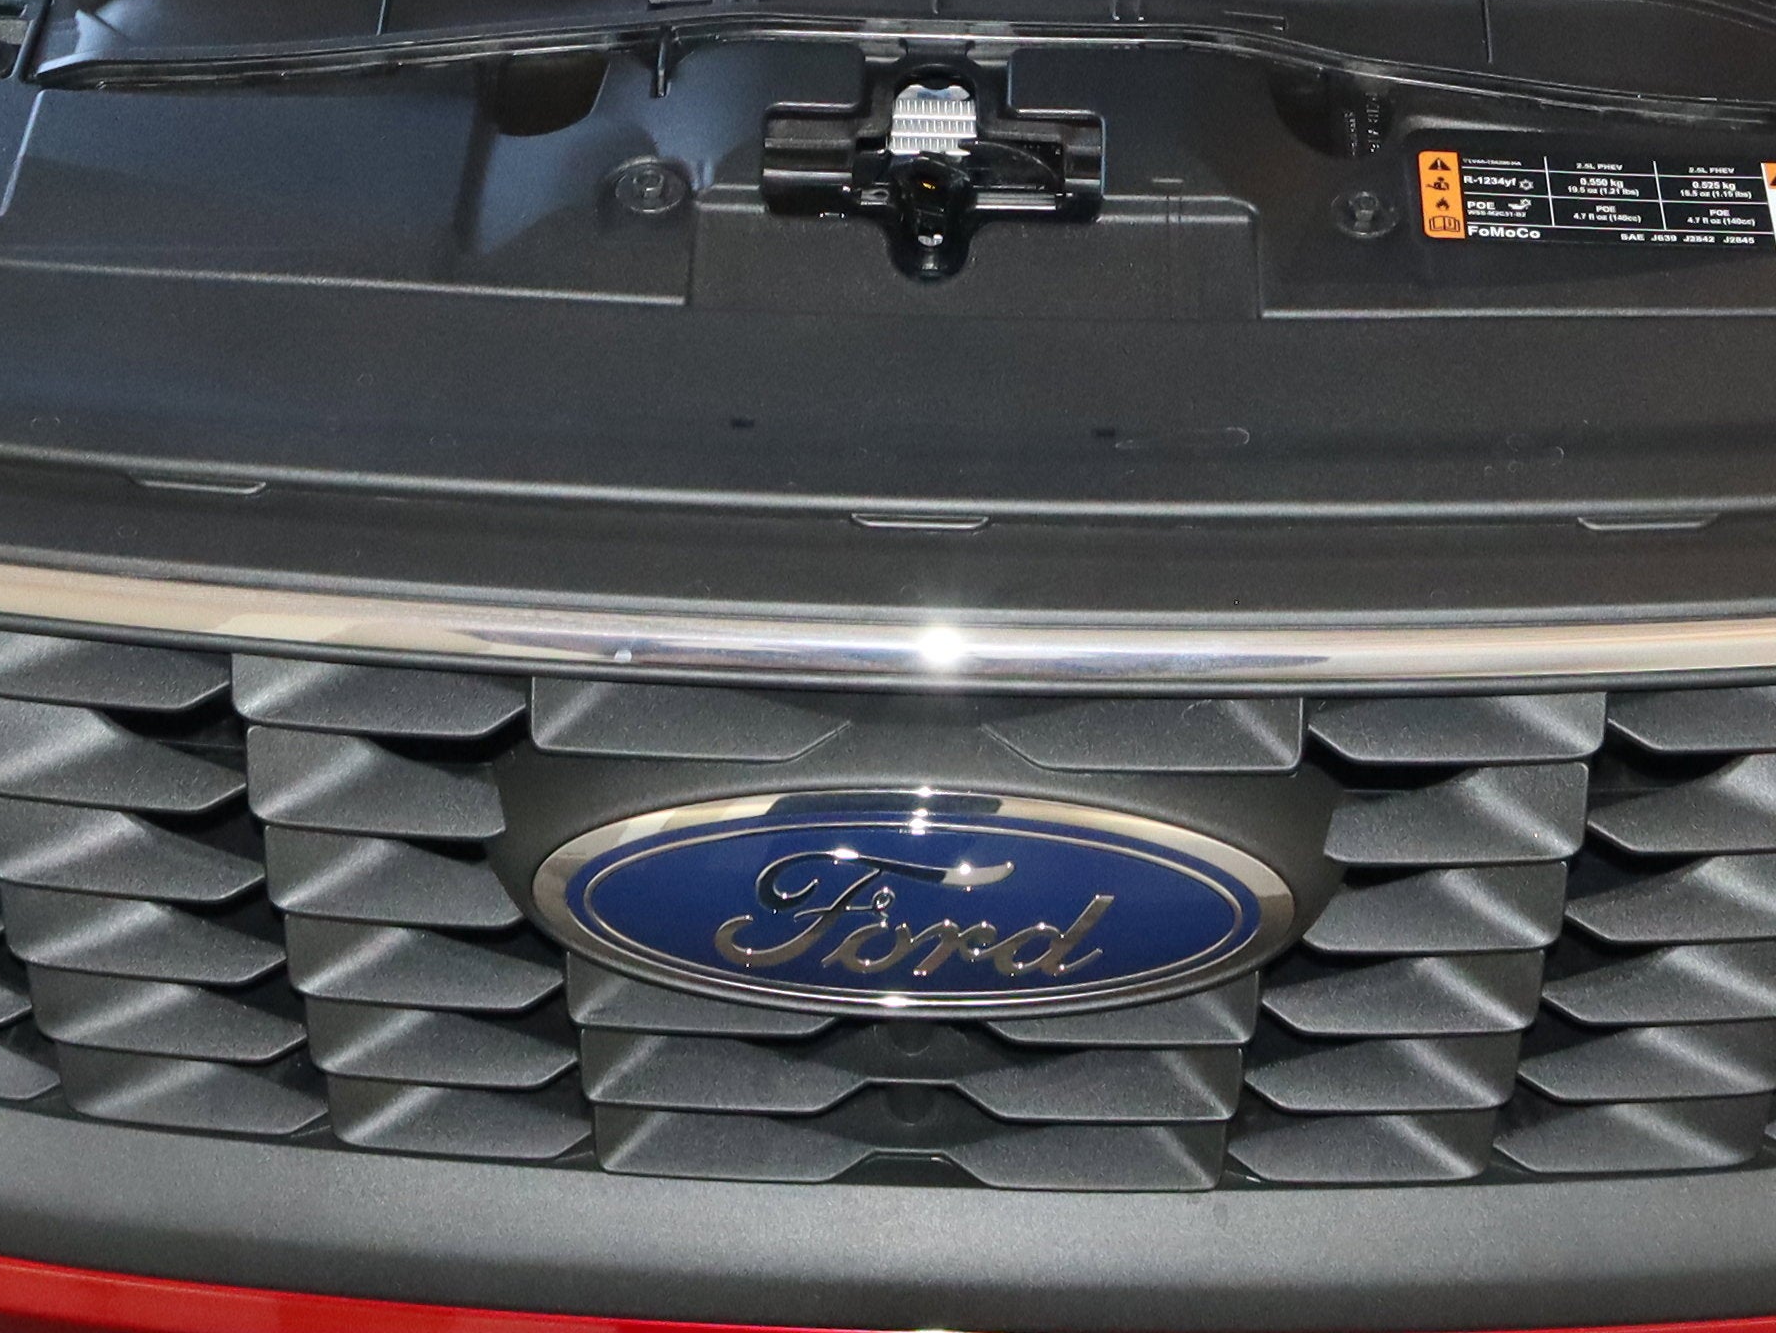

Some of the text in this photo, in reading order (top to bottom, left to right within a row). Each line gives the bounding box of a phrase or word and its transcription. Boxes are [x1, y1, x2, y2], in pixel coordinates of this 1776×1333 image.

[1462, 175, 1517, 188] R-1234yf
[1579, 177, 1624, 188] 0.550 kg
[1692, 181, 1736, 191] 0.525 kg
[1467, 201, 1495, 210] POE
[1595, 205, 1617, 213] POE
[1709, 209, 1730, 217] POE
[1467, 225, 1541, 239] FoMoCo
[1651, 234, 1677, 242] J639
[714, 849, 1114, 976] Ford
